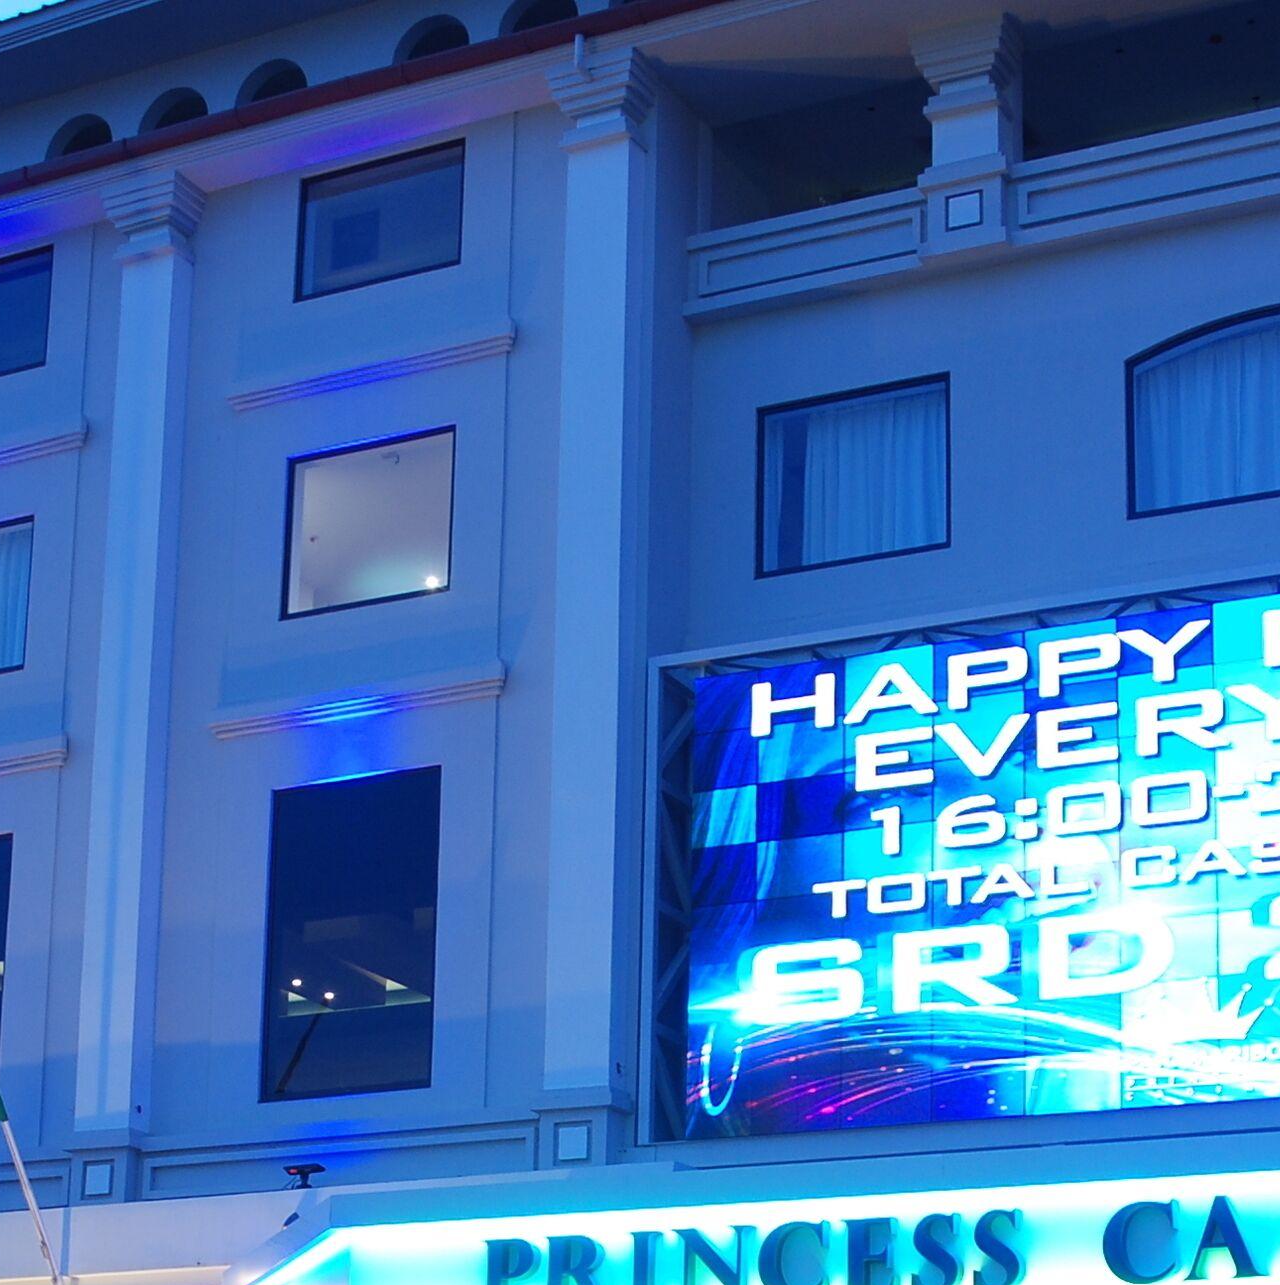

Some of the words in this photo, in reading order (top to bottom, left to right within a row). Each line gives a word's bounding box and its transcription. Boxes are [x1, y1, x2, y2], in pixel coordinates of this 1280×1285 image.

[751, 619, 1211, 737] HAPPY
[812, 862, 1093, 918] TOTAL
[750, 906, 1175, 1025] SRD
